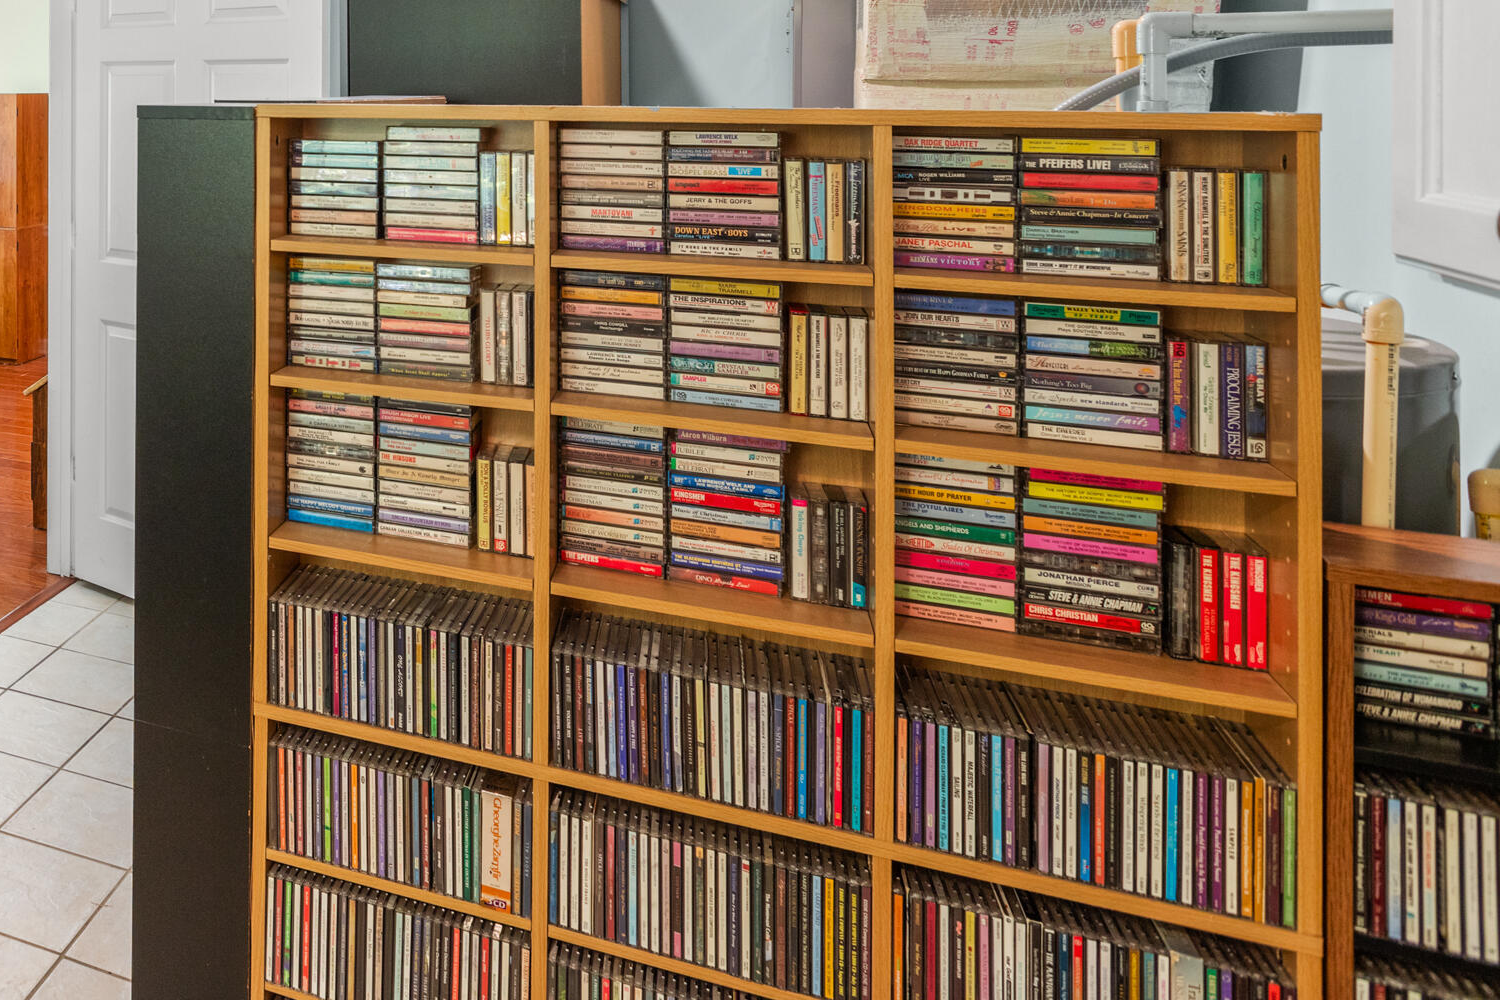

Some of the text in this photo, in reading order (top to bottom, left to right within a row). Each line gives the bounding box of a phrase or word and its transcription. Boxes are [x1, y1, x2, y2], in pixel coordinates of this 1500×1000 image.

[1040, 158, 1084, 169] PFEIFERS
[895, 238, 973, 248] JANET PASCHAL
[690, 297, 746, 306] INSPIRATIONS
[1224, 368, 1240, 458] PROCLAIMING JESUS
[681, 431, 727, 442] Aaron Wilburn
[674, 490, 705, 501] KINGSMEN
[946, 493, 972, 501] PRAYER
[935, 525, 970, 534] SHEPHERDS
[566, 551, 576, 560] THE
[1203, 555, 1212, 567] THE
[1230, 557, 1240, 570] THE
[1038, 572, 1120, 588] JONATHAN PIERCE
[1049, 591, 1143, 613] STEVE & ANNIE CHAPMAN
[1029, 605, 1098, 622] CHRIS CHRISTIAN
